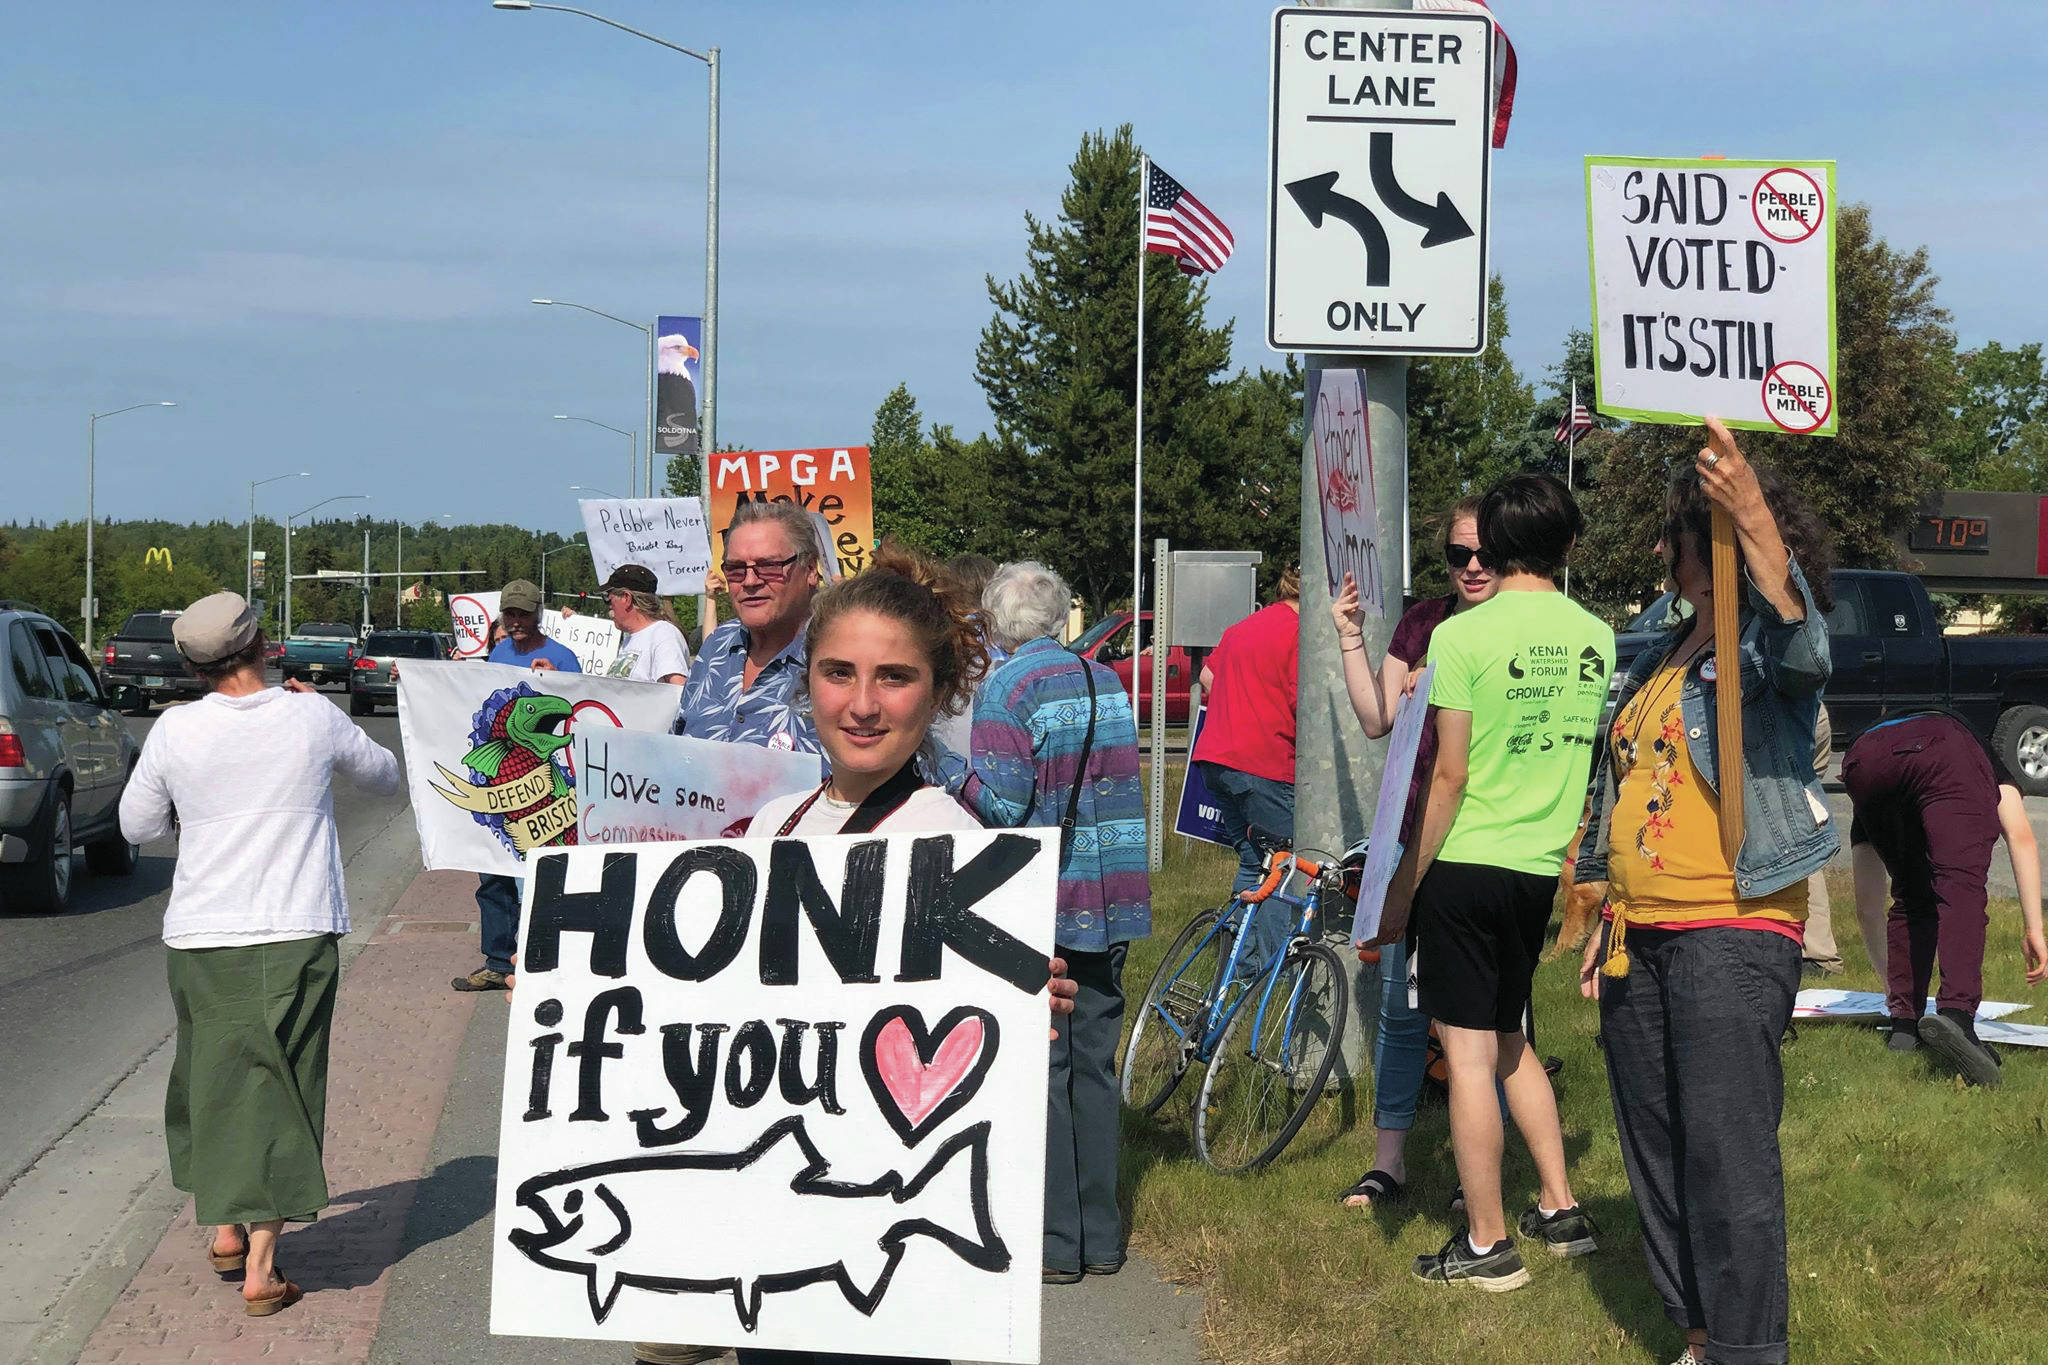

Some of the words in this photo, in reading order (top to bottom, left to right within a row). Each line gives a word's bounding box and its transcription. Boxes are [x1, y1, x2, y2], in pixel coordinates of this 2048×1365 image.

[1304, 29, 1462, 64] CENTER
[1328, 75, 1436, 107] LANE
[1622, 170, 1728, 226] SAID
[1758, 192, 1817, 206] PEBBLE
[1767, 208, 1809, 222] MINE
[1327, 301, 1426, 333] ONLY
[1768, 383, 1825, 400] PEBBLE
[1776, 398, 1817, 414] MINE
[657, 426, 698, 435] SOLDOTNA
[1319, 379, 1364, 484] Protect
[716, 450, 856, 490] MPGA
[600, 507, 655, 533] Pebble
[664, 506, 701, 530] Never
[626, 540, 659, 552] Bristol
[665, 540, 684, 552] Bay
[667, 560, 710, 575] Forever!
[569, 626, 579, 642] is
[585, 624, 613, 648] not
[1529, 646, 1568, 657] KENAI
[1531, 666, 1568, 676] FORUM
[1506, 686, 1563, 700] CROWLEY
[1521, 714, 1538, 722] Rotary
[1562, 715, 1593, 724] SAFEWAY
[585, 737, 661, 803] Have
[676, 787, 726, 813] some
[487, 775, 546, 810] DEFEND
[526, 797, 577, 841] BRISTO
[1198, 803, 1225, 823] VOT
[524, 834, 1051, 995] HONK
[522, 986, 647, 1122] if
[628, 1018, 847, 1149] you
